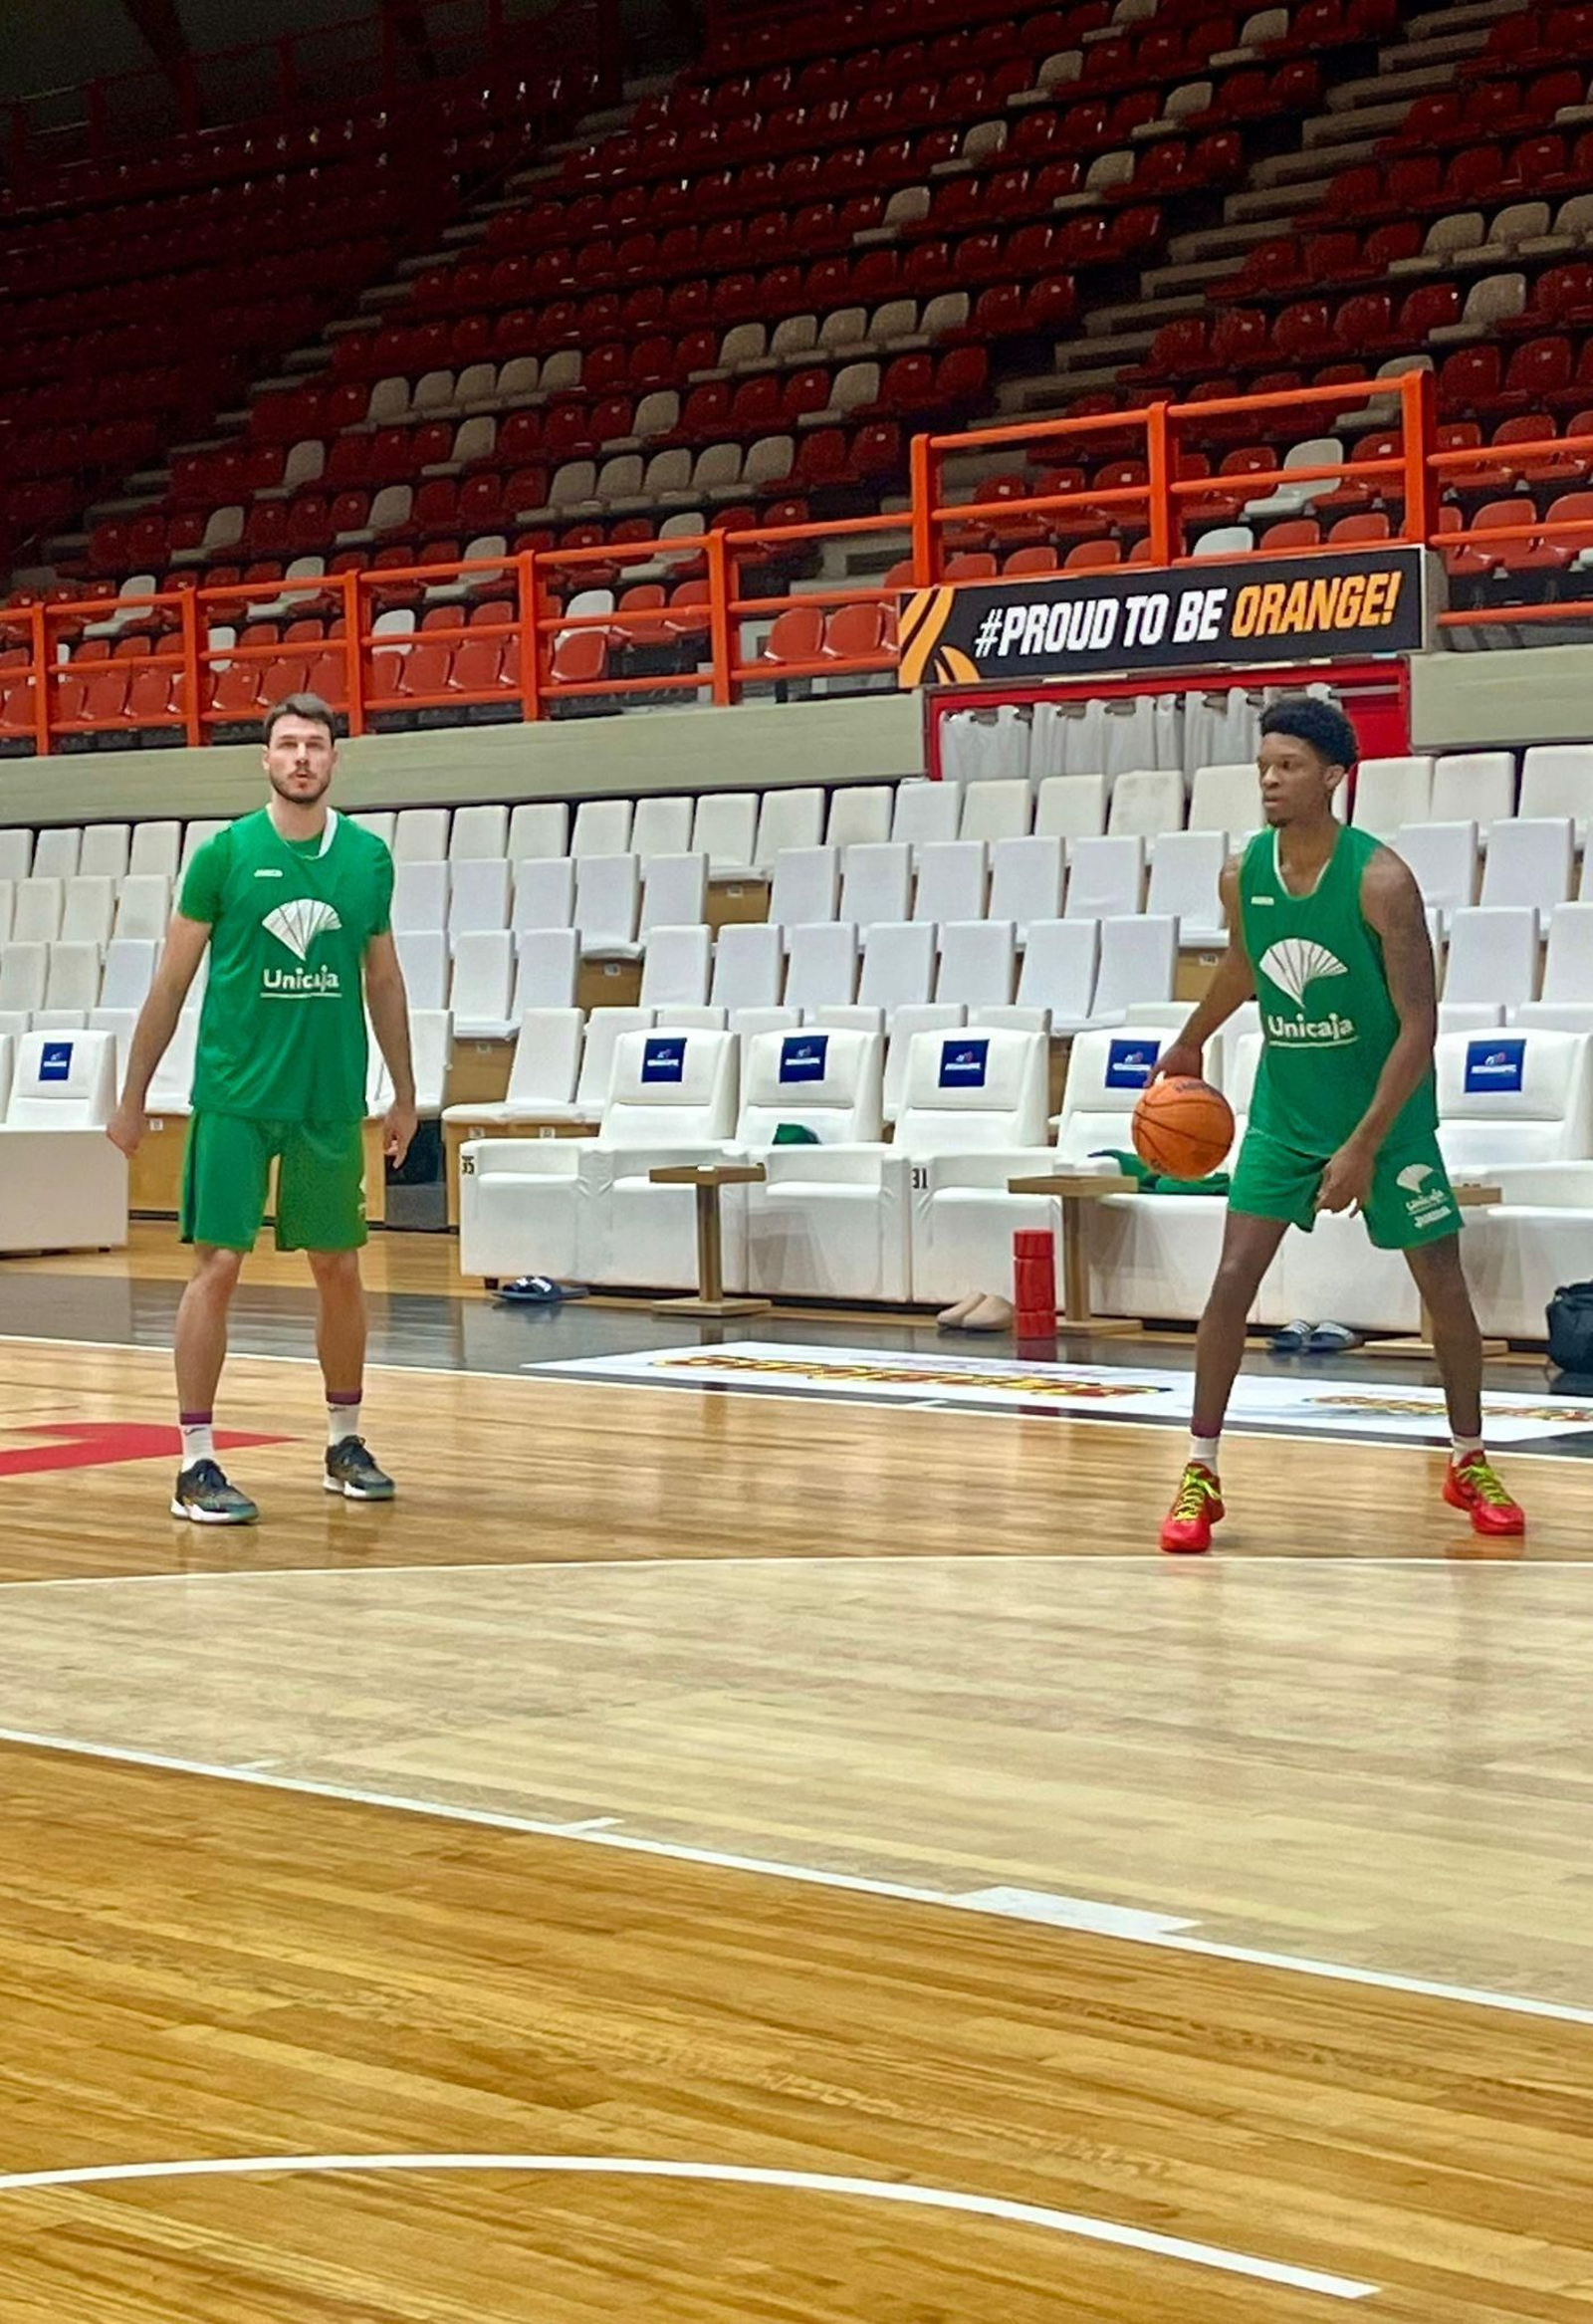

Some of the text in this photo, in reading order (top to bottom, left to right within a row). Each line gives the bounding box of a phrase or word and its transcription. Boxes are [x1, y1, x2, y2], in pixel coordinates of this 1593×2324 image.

[974, 571, 1403, 658] #PROUD TO BE ORANGE!
[1267, 1013, 1355, 1041] Unicaja
[911, 1167, 928, 1189] 31
